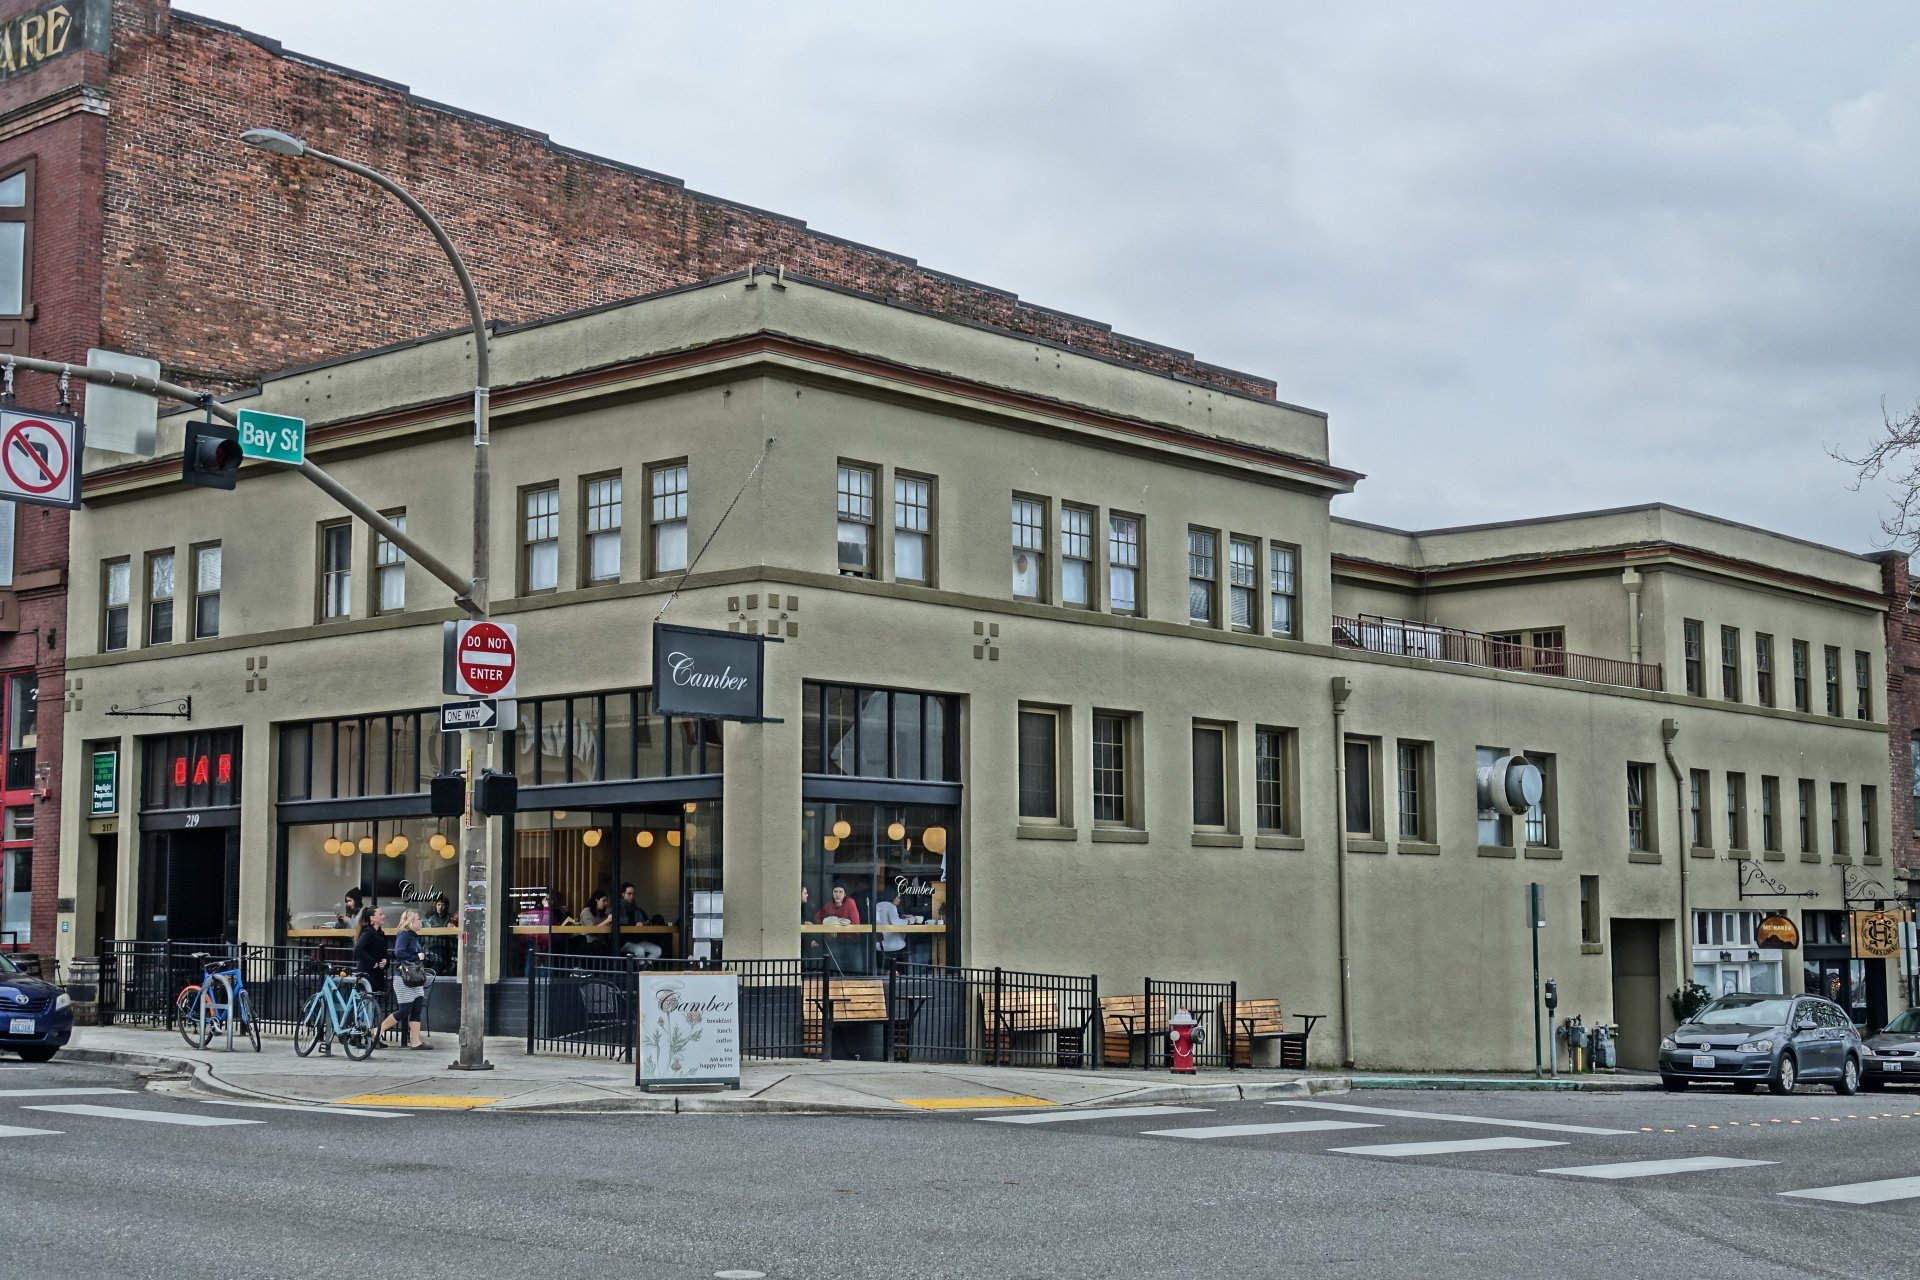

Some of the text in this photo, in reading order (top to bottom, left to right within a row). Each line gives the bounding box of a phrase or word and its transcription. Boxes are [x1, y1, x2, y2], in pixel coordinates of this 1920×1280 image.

[242, 421, 299, 453] Bay St
[467, 635, 508, 650] DO NOT
[470, 668, 503, 681] ENTER
[667, 651, 748, 690] Camber
[447, 709, 480, 721] ONE WAY
[175, 754, 231, 787] BAR
[102, 823, 113, 832] 217
[185, 814, 200, 828] 219
[398, 879, 443, 902] Camber
[894, 875, 935, 896] Camber
[655, 988, 734, 1013] Camber
